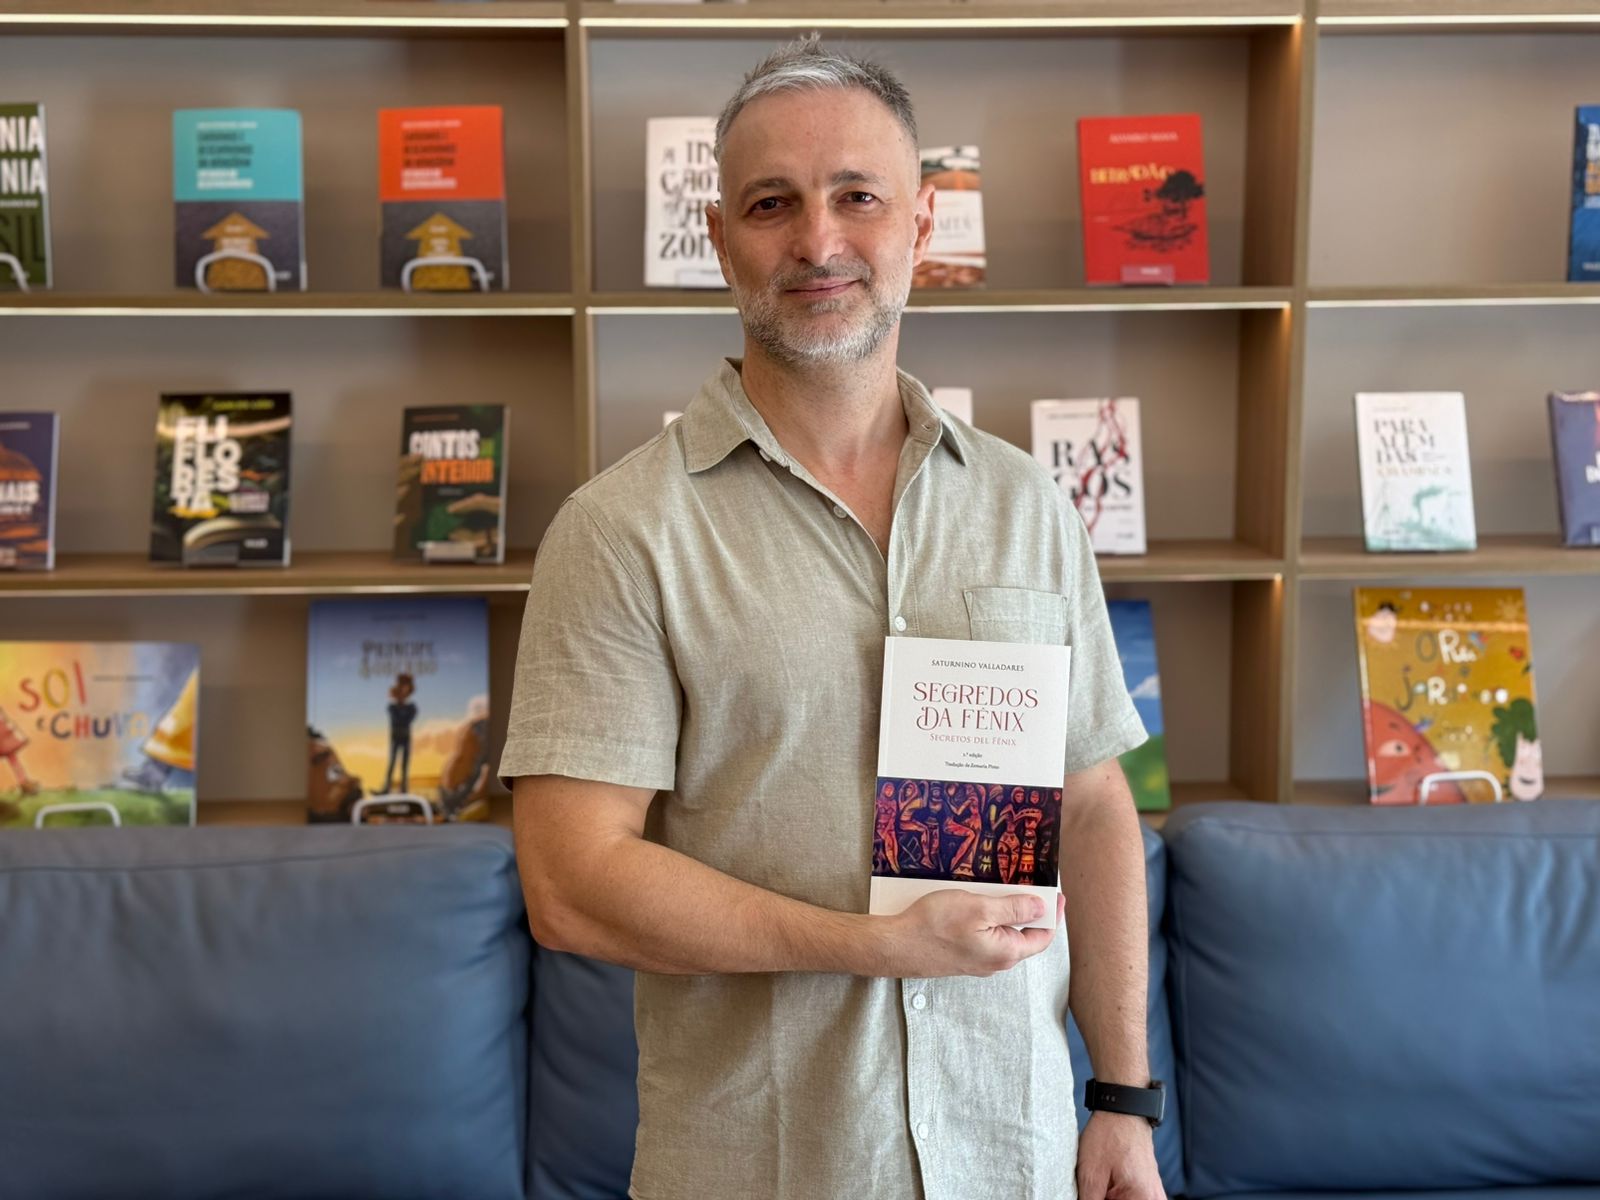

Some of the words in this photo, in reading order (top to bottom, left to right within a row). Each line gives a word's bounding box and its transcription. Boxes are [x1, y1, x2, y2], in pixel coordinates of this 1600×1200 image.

[931, 660, 976, 669] SATURNINO
[978, 662, 1024, 672] VALLADARES
[912, 681, 1038, 709] SEGREDOS
[916, 706, 952, 731] DA
[962, 707, 1025, 732] FÊNIX
[930, 733, 971, 745] SECRETOS
[973, 735, 990, 745] DEL
